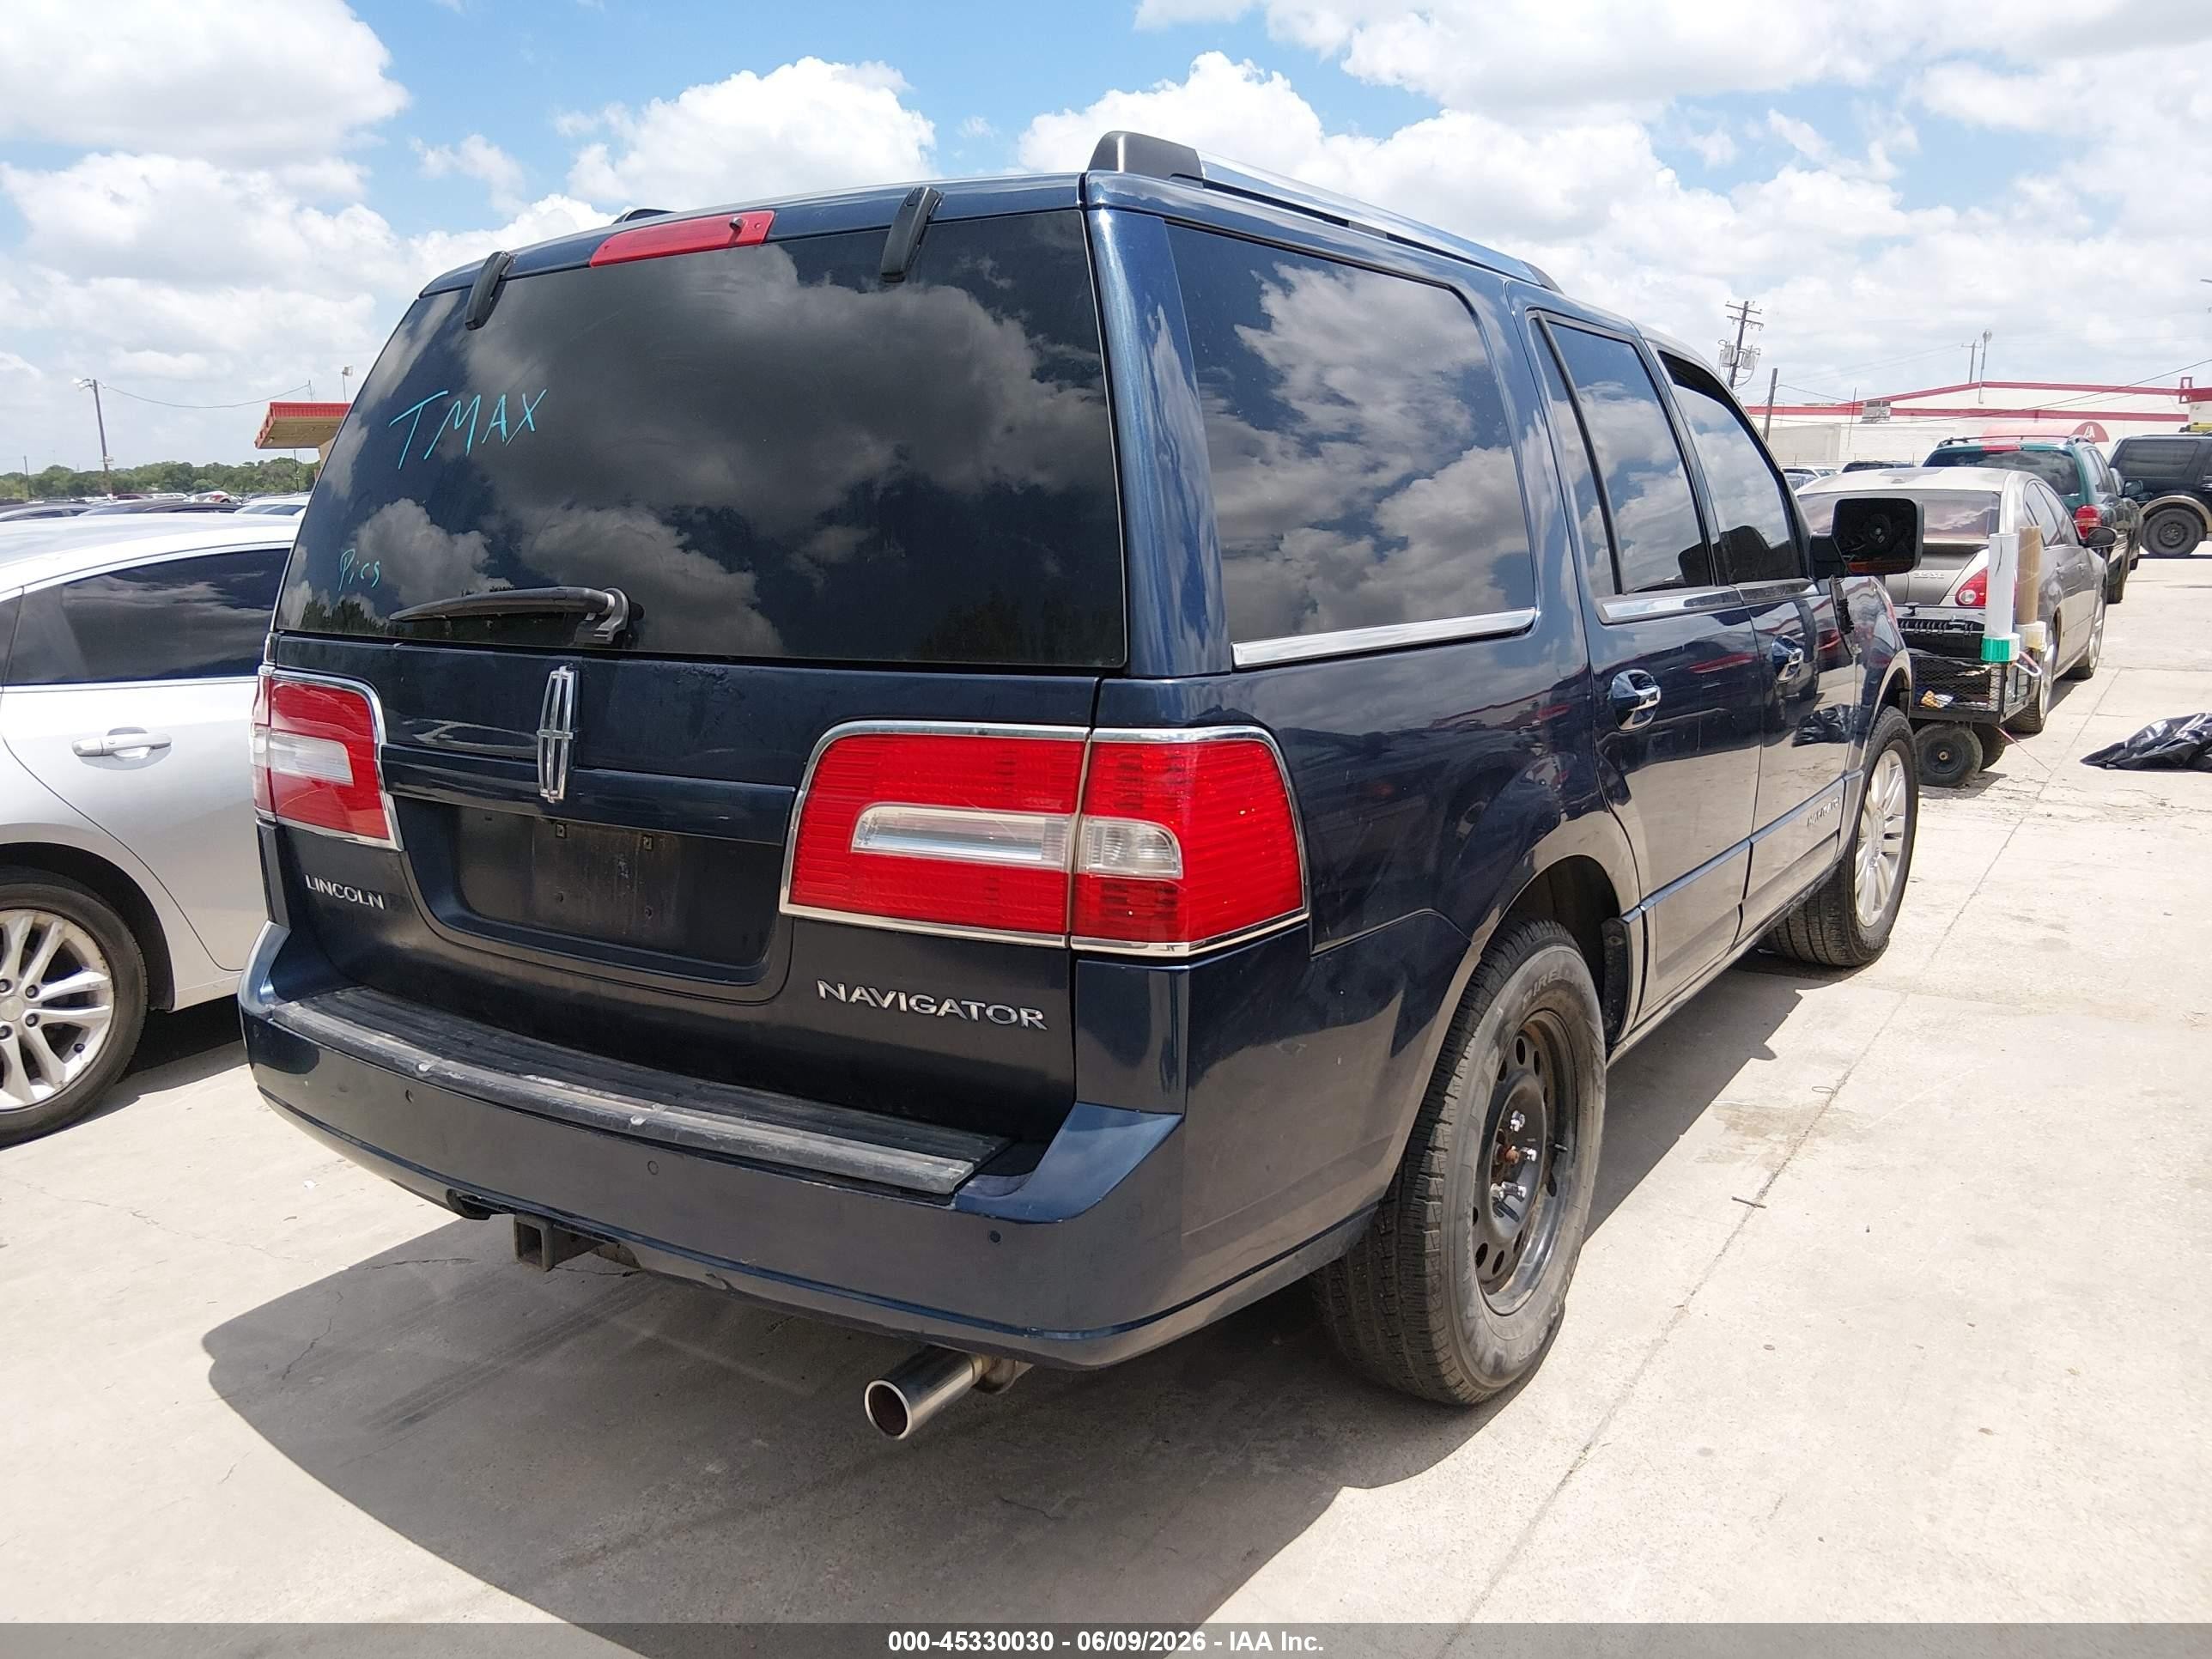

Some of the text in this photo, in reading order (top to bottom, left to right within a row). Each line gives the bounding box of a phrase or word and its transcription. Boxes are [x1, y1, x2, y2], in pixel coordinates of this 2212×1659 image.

[388, 389, 547, 471] TMAX
[304, 874, 385, 911] LINCOLN
[817, 979, 1048, 1031] NAVIGATOR
